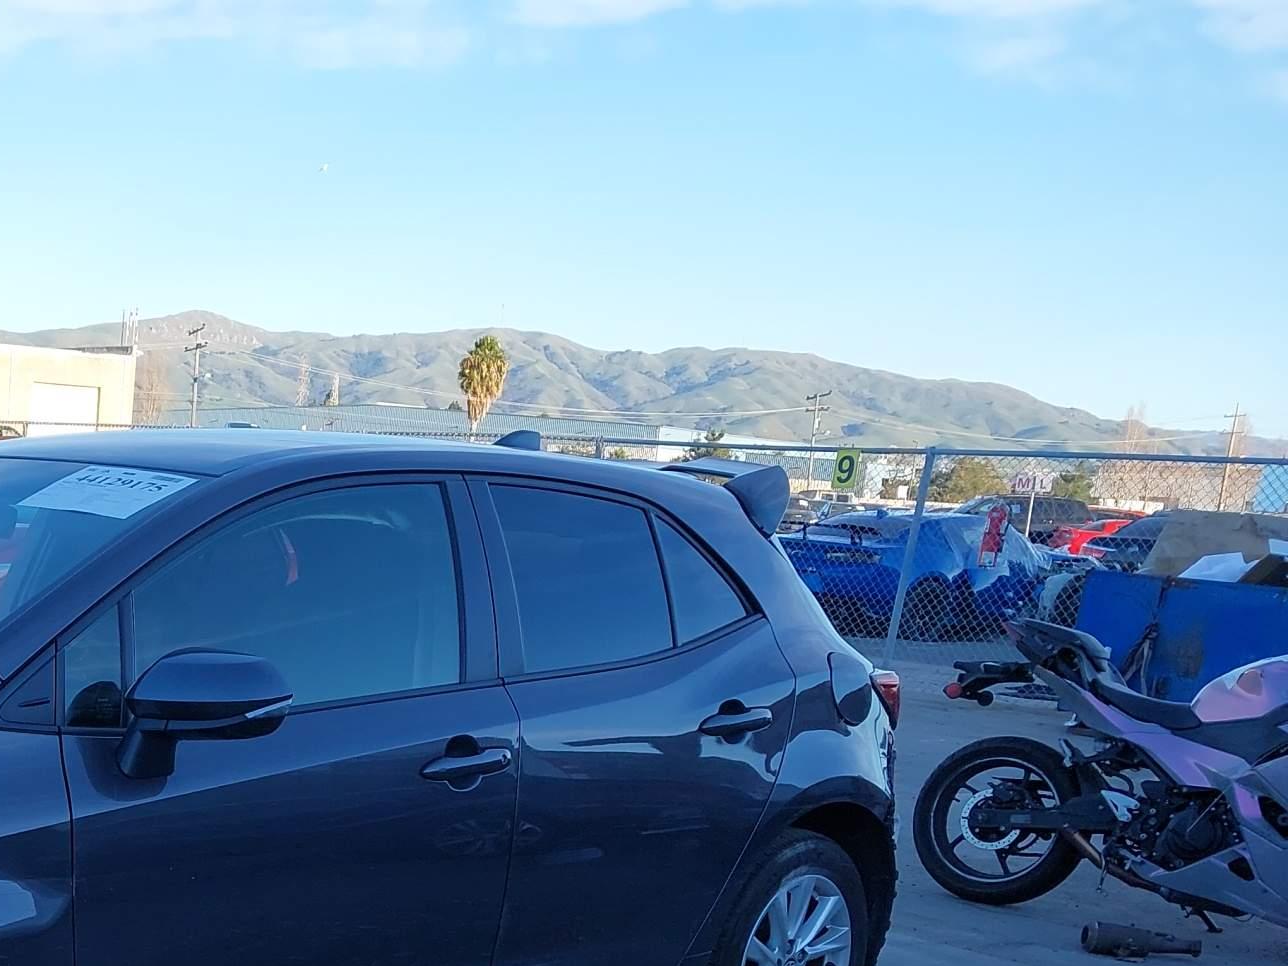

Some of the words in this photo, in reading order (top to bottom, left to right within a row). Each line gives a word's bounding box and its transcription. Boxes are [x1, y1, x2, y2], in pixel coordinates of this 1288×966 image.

[836, 455, 855, 484] 9
[76, 474, 169, 493] 44129175
[1017, 477, 1031, 489] M
